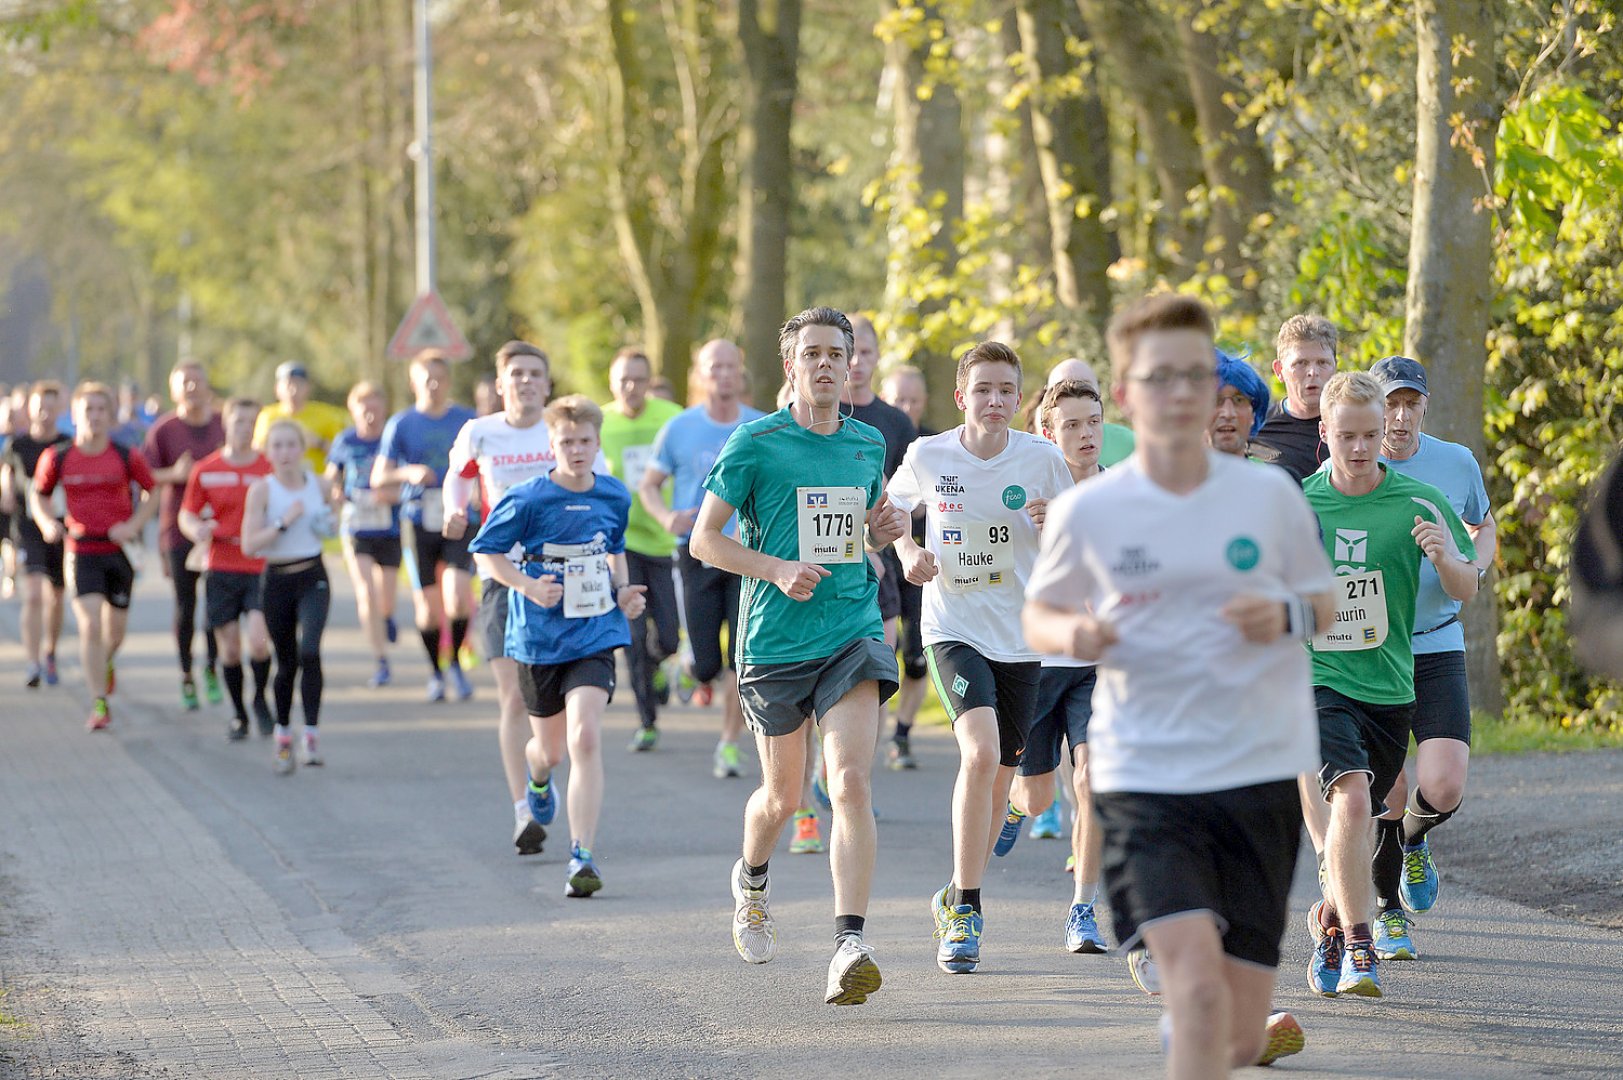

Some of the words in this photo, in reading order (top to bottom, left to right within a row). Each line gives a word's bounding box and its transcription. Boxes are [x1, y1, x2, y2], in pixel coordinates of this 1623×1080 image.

[935, 485, 965, 493] UKENA
[812, 513, 853, 536] 1779
[989, 525, 1009, 544] 93
[958, 552, 993, 566] Hauke
[1346, 577, 1378, 599] 271
[1334, 605, 1366, 622] aurin
